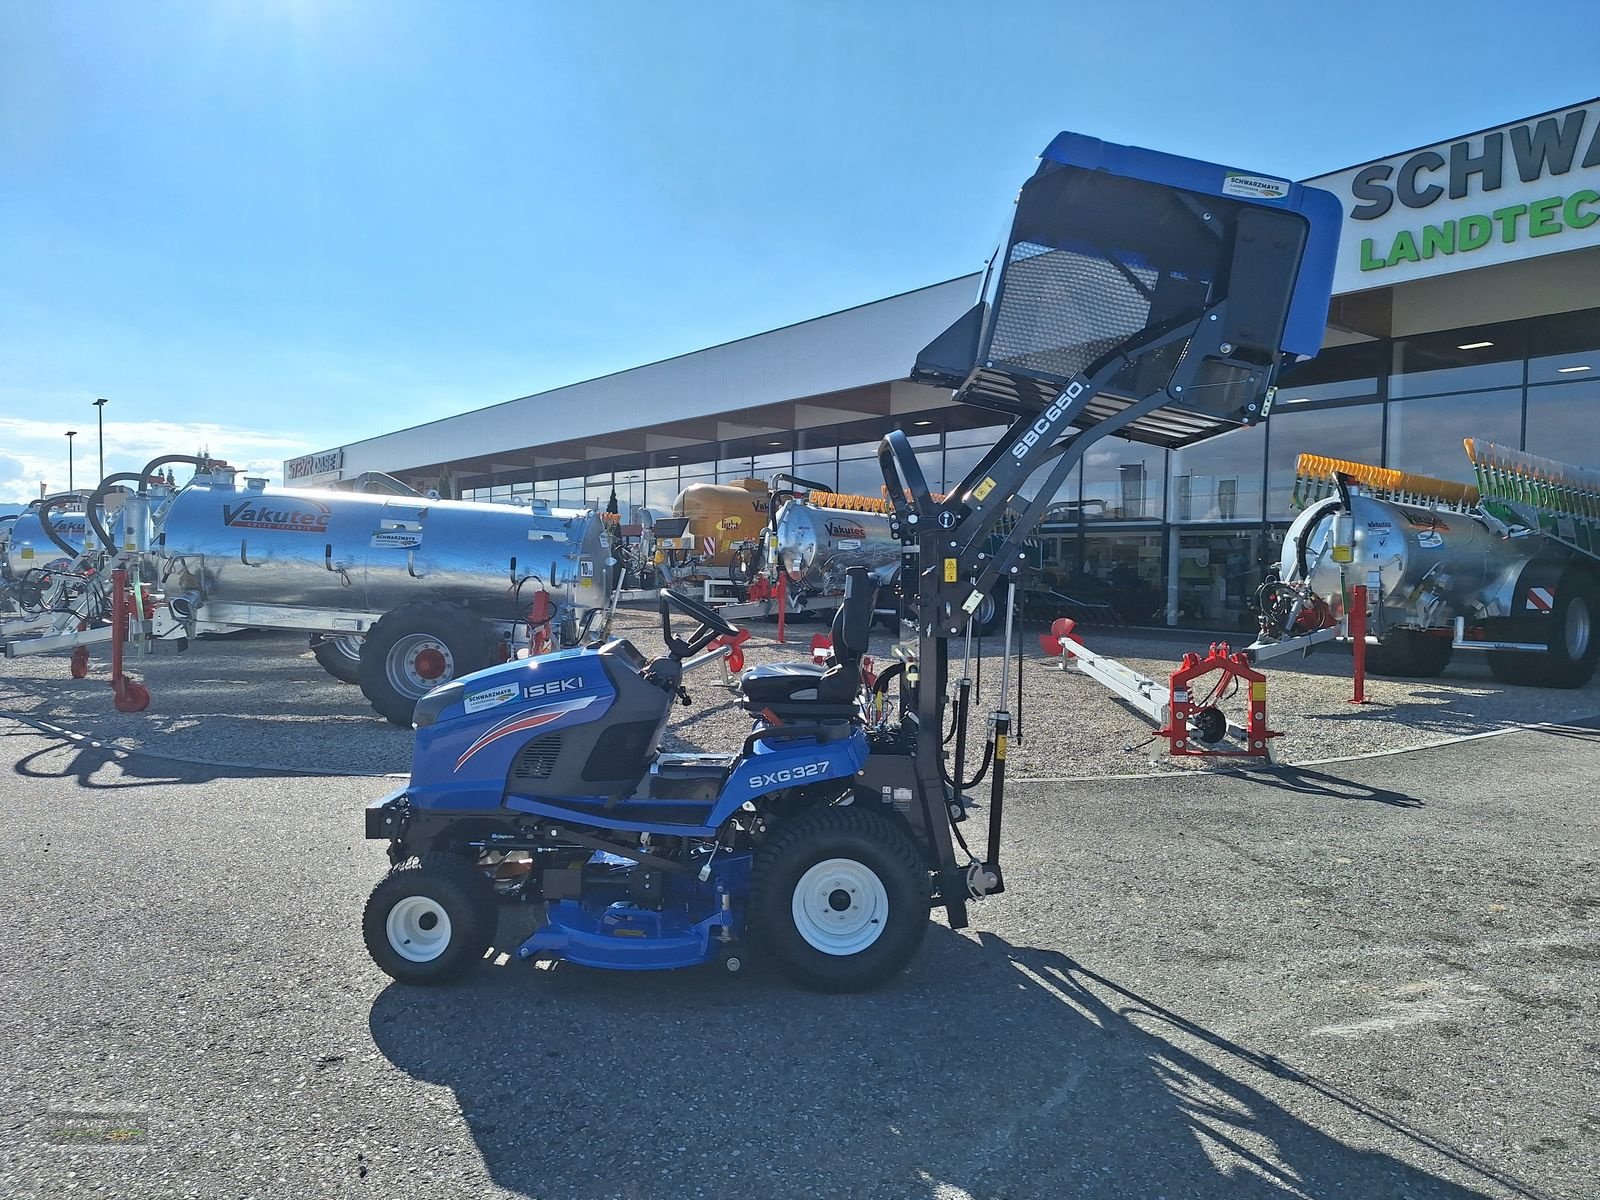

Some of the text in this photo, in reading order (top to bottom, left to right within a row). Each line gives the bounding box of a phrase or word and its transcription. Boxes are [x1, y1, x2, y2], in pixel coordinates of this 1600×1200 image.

[1230, 177, 1280, 191] SCHWARZMAYR
[1011, 381, 1084, 459] SBC650
[288, 457, 314, 479] STEYR
[223, 501, 331, 527] Vakutec
[824, 522, 866, 537] Vakutec
[469, 688, 512, 702] SCHWARZMAYR
[523, 677, 583, 698] ISEKI
[749, 761, 830, 788] SXG327
